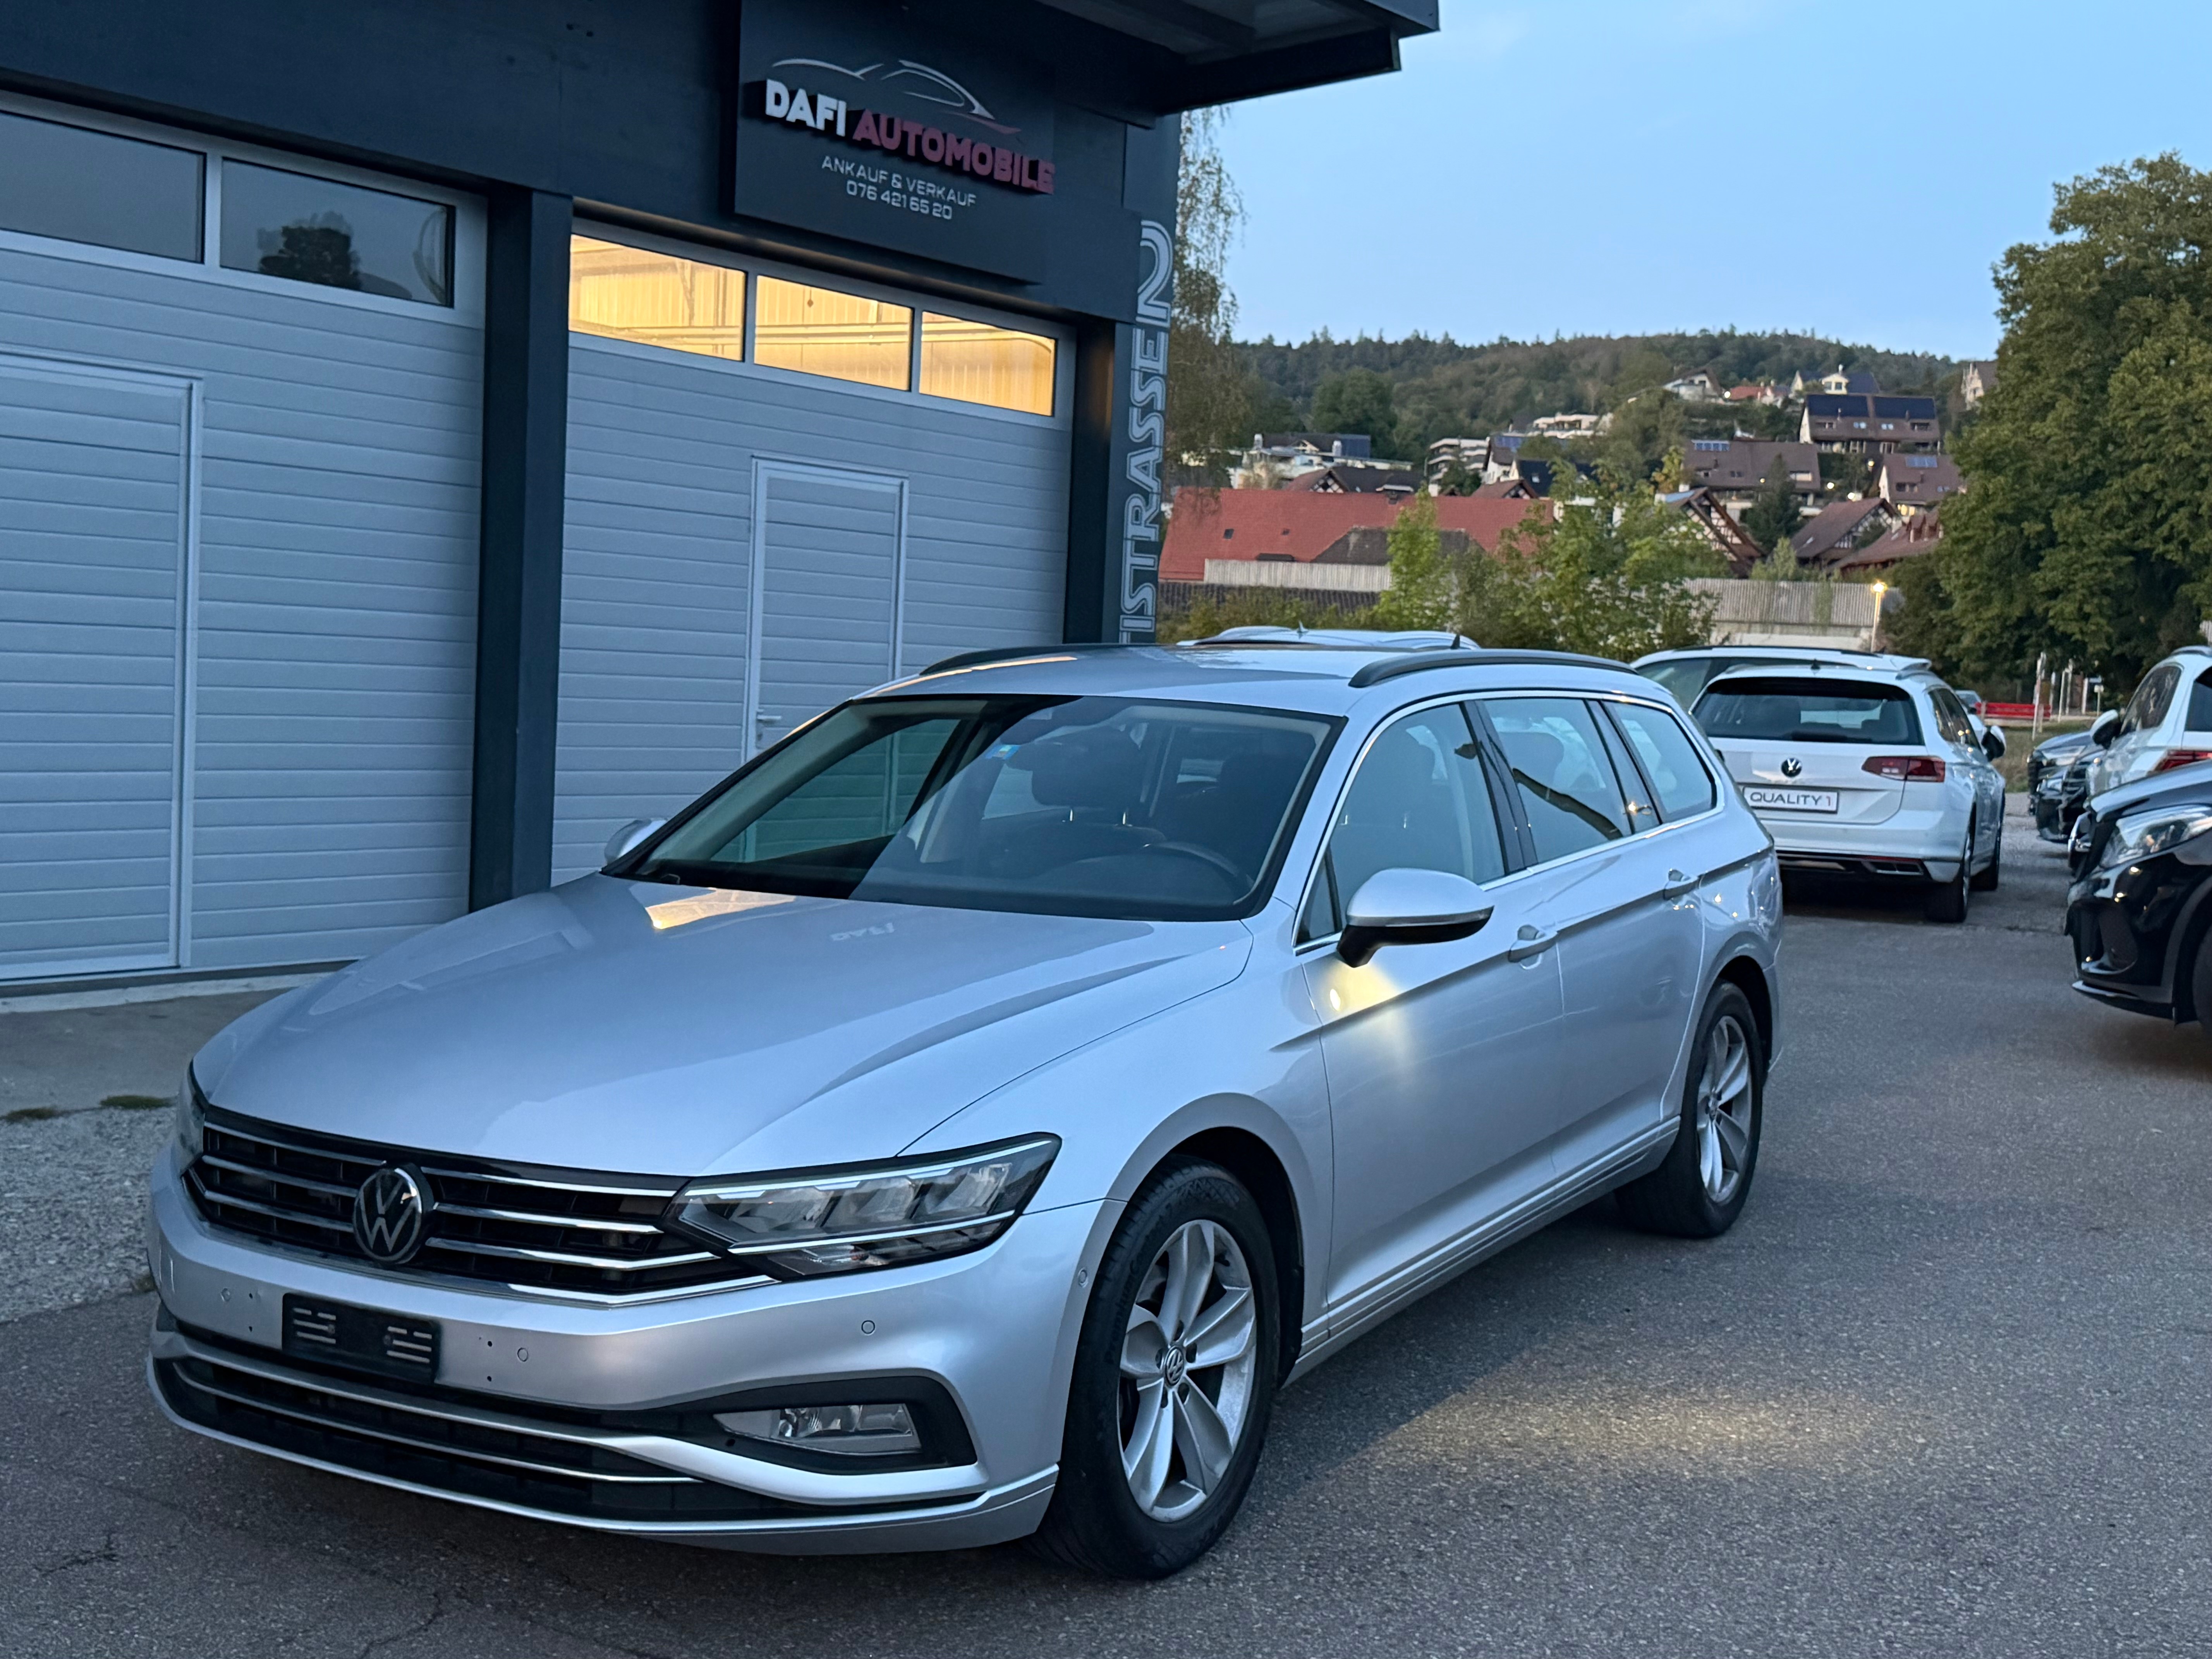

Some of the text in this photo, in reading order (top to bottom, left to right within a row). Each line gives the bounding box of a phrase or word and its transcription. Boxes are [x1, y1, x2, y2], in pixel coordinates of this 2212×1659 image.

[765, 79, 1054, 194] DAFI AUTOMOBILE
[821, 156, 976, 207] ANKAUF & VERKAUF
[847, 180, 878, 201] 076
[932, 202, 952, 220] 20
[1119, 328, 1169, 644] ISTRASSE
[1750, 792, 1831, 806] QUALITY 1
